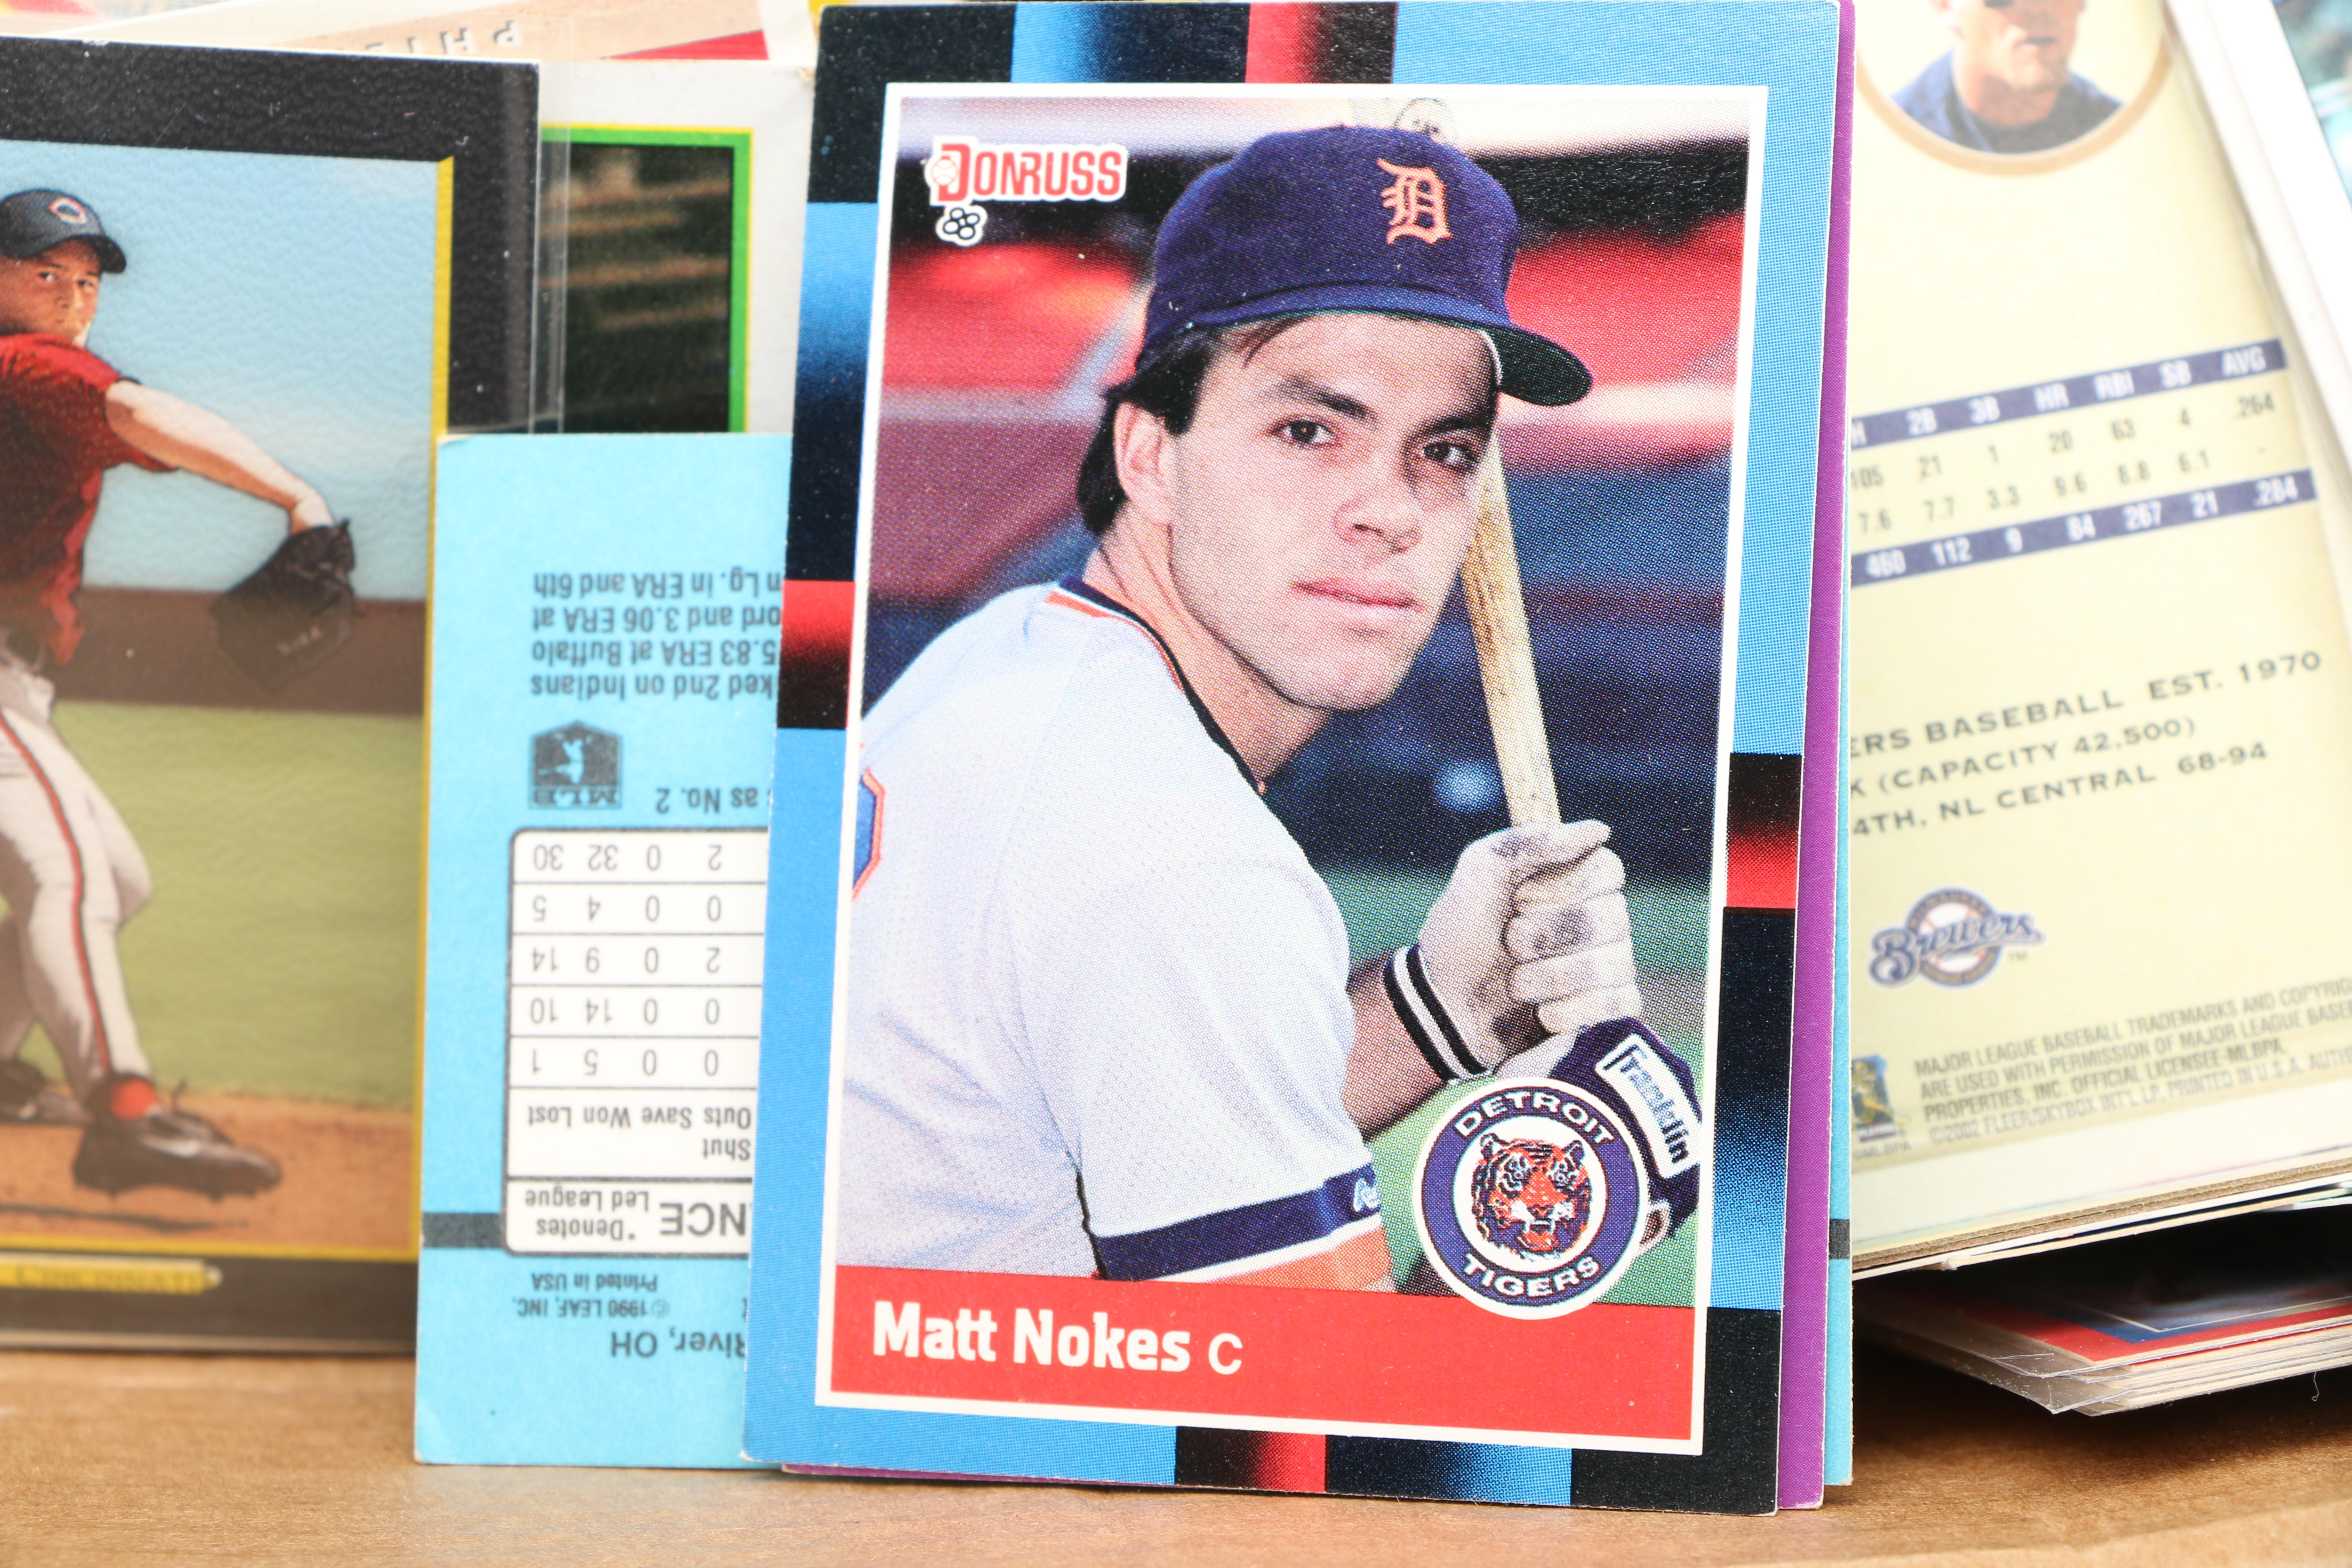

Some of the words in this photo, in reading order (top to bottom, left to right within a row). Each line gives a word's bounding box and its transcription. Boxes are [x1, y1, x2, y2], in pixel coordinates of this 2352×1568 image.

[931, 143, 1122, 202] DONRUSS
[1376, 157, 1454, 246] D
[1851, 420, 1867, 447] H
[1905, 406, 1938, 436] 2B
[1969, 395, 2000, 425] 3B
[2034, 383, 2069, 411] HR
[2094, 370, 2135, 401] RBI
[2159, 359, 2191, 388] SB
[2221, 346, 2267, 377] AVG
[1851, 465, 1884, 489] 105
[1919, 454, 1942, 478] 21
[1988, 443, 1998, 463] 1
[2049, 429, 2073, 453] 20
[2111, 417, 2136, 441] 63
[2180, 407, 2191, 426] 4
[2235, 391, 2275, 419] .264
[1858, 508, 1891, 533] 7.6
[1923, 496, 1954, 521] 7.7
[1987, 485, 2020, 510] 3.3
[2178, 449, 2209, 473] 6.1
[1865, 549, 1907, 578] 460
[1931, 536, 1972, 567] 112
[2004, 527, 2023, 554] 9
[2066, 514, 2096, 542] 84
[2123, 500, 2162, 531] 267
[2190, 490, 2219, 519] 21
[533, 574, 572, 598] 6th
[581, 574, 624, 598] and
[633, 574, 682, 597] ERA
[692, 574, 713, 597] in
[721, 567, 757, 597] Lg.
[532, 608, 554, 630] at
[564, 607, 613, 631] ERA
[624, 607, 678, 631] 3.06
[688, 607, 733, 631] and
[532, 641, 620, 665] Buffalo
[631, 641, 652, 662] at
[662, 641, 711, 664] ERA
[721, 640, 775, 664] 5.83
[531, 675, 625, 698] Indians
[635, 675, 664, 693] on
[673, 675, 719, 699] 2nd
[1926, 690, 2124, 743] BASEBALL
[2147, 670, 2223, 701] EST.
[2239, 650, 2321, 683] 1970
[1879, 741, 2058, 795] (CAPACITY
[2074, 717, 2195, 753] 42,500)
[531, 788, 618, 806] MLB
[681, 788, 720, 813] No.
[731, 788, 757, 809] as
[1853, 809, 1926, 835] 4TH,
[1940, 798, 1985, 821] NL
[1997, 765, 2157, 809] CENTRAL
[2178, 742, 2268, 775] 68-94
[655, 789, 669, 813] 2
[533, 845, 563, 870] 30
[588, 845, 618, 870] 32
[647, 845, 660, 870] 0
[708, 845, 722, 870] 2
[533, 896, 546, 920] 5
[587, 896, 601, 920] 4
[646, 896, 659, 920] 0
[707, 896, 721, 921] 0
[531, 947, 559, 971] 14
[585, 947, 599, 971] 9
[645, 948, 658, 972] 0
[707, 947, 720, 972] 2
[1868, 913, 2046, 987] Brewers
[530, 998, 557, 1023] 10
[585, 998, 612, 1023] 14
[644, 998, 657, 1023] 0
[706, 998, 719, 1023] 0
[1916, 1052, 1972, 1077] MAJOR
[1976, 1038, 2040, 1064] LEAGUE
[2043, 1023, 2123, 1052] BASEBALL
[2128, 1001, 2238, 1035] TRADEMARKS
[2244, 993, 2276, 1012] AND
[2281, 977, 2352, 1005] COPYRIG
[531, 1050, 539, 1074] 1
[584, 1049, 598, 1075] 5
[643, 1050, 656, 1075] 0
[705, 1050, 718, 1075] 0
[1922, 1080, 1953, 1099] ARE
[1956, 1071, 1999, 1093] USED
[2005, 1061, 2046, 1083] WITH
[2051, 1041, 2150, 1073] PERMISSION
[2155, 1035, 2174, 1053] OF
[2181, 1023, 2236, 1047] MAJOR
[2241, 1011, 2303, 1036] LEAGUE
[2072, 1066, 2144, 1093] OFFICIAL
[2168, 1072, 2234, 1097] PRINTED
[2238, 1067, 2254, 1083] IN
[528, 1106, 572, 1127] Lost
[584, 1107, 630, 1127] Won
[641, 1107, 692, 1128] Save
[704, 1107, 751, 1129] Outs
[1453, 1090, 1616, 1144] DETROIT
[702, 1139, 750, 1160] Shut
[525, 1188, 602, 1210] League
[612, 1191, 649, 1210] Led
[659, 1202, 750, 1235] NCE
[531, 1274, 566, 1291] USA
[575, 1275, 588, 1291] in
[597, 1274, 657, 1292] Printed
[1464, 1252, 1602, 1297] TIGERS
[512, 1298, 547, 1317] INC.
[555, 1298, 601, 1316] LEAF,
[611, 1331, 657, 1358] OH
[873, 1300, 998, 1362] Matt
[1013, 1308, 1191, 1372] Nokes
[1207, 1332, 1243, 1375] C
